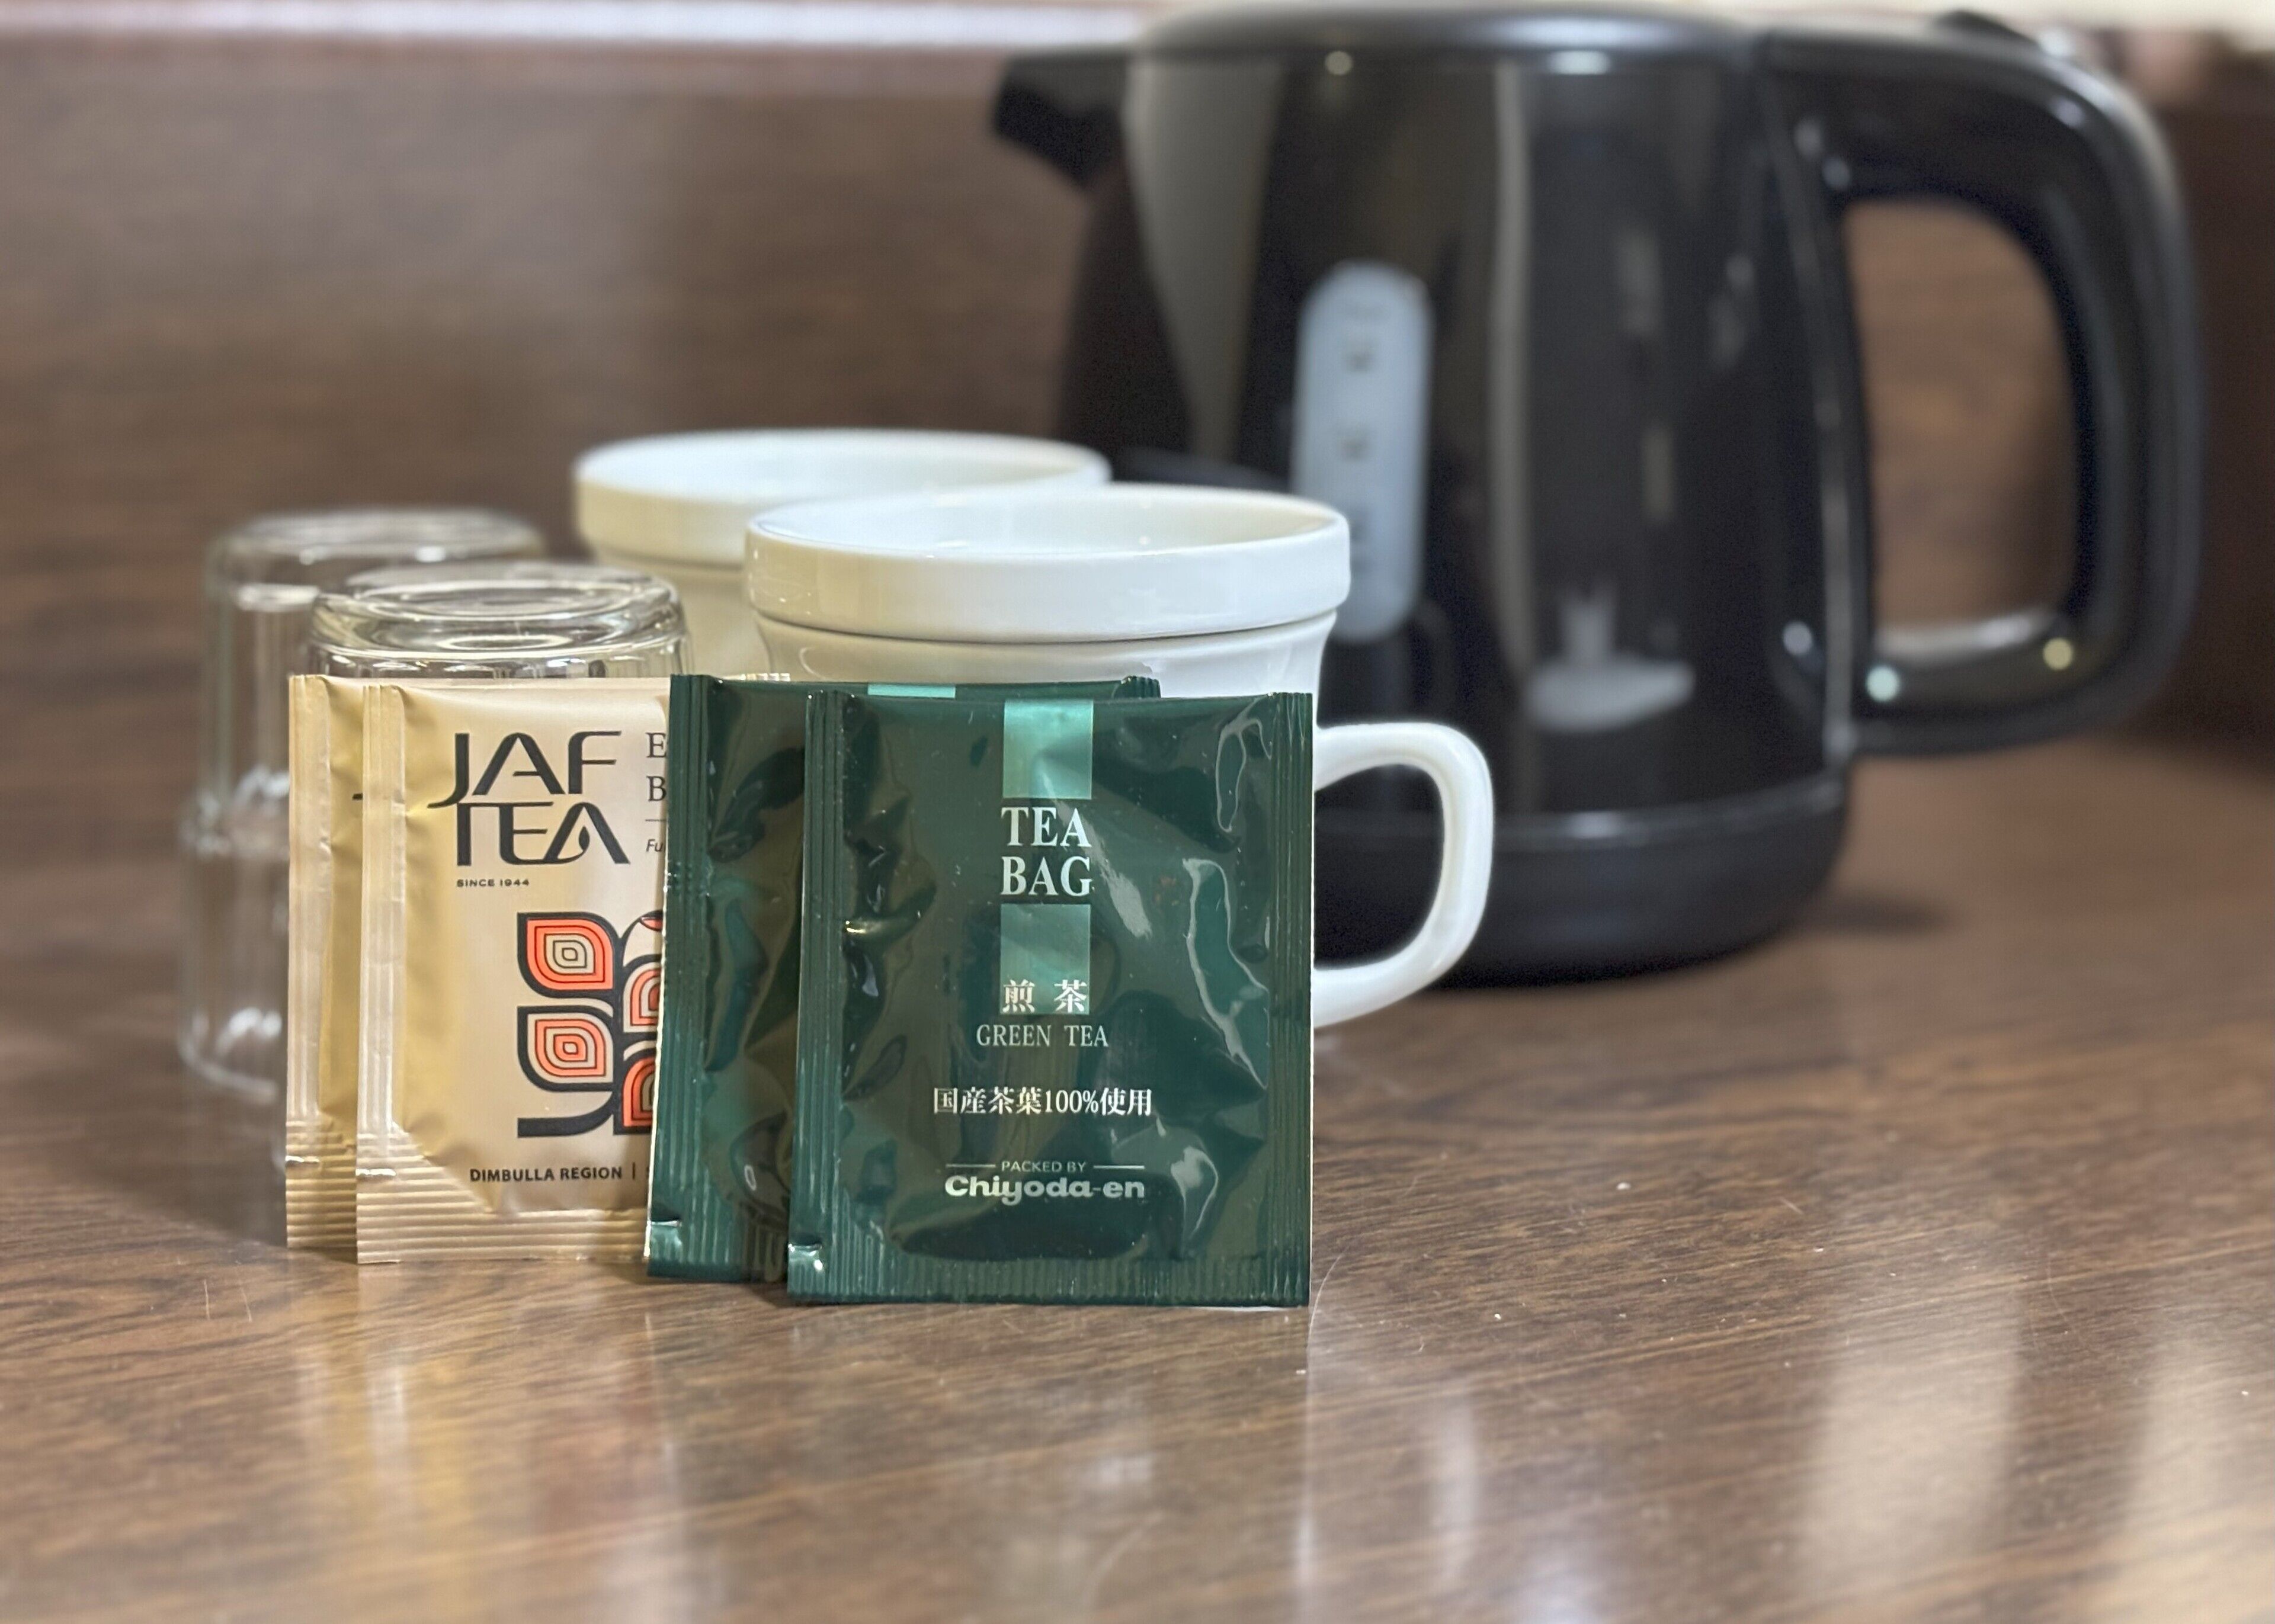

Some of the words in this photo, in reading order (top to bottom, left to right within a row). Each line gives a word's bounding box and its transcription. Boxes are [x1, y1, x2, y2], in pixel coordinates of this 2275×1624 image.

[427, 731, 621, 808] JAF
[456, 801, 630, 866] TEA
[1001, 807, 1092, 847] TEA
[456, 878, 495, 887] SINCE
[499, 878, 530, 887] 1944
[1001, 856, 1094, 897] BAG
[1002, 979, 1088, 1014] 煎茶
[976, 1025, 1052, 1048] GREEN
[1064, 1025, 1109, 1047] TEA
[933, 1086, 1152, 1116] 国産茶葉100%使用
[470, 1168, 555, 1182] DIMBULLA
[560, 1167, 622, 1180] REGION
[1001, 1160, 1062, 1173] PACKED
[1066, 1161, 1087, 1173] BY
[945, 1175, 1145, 1206] Chiyoda-en
